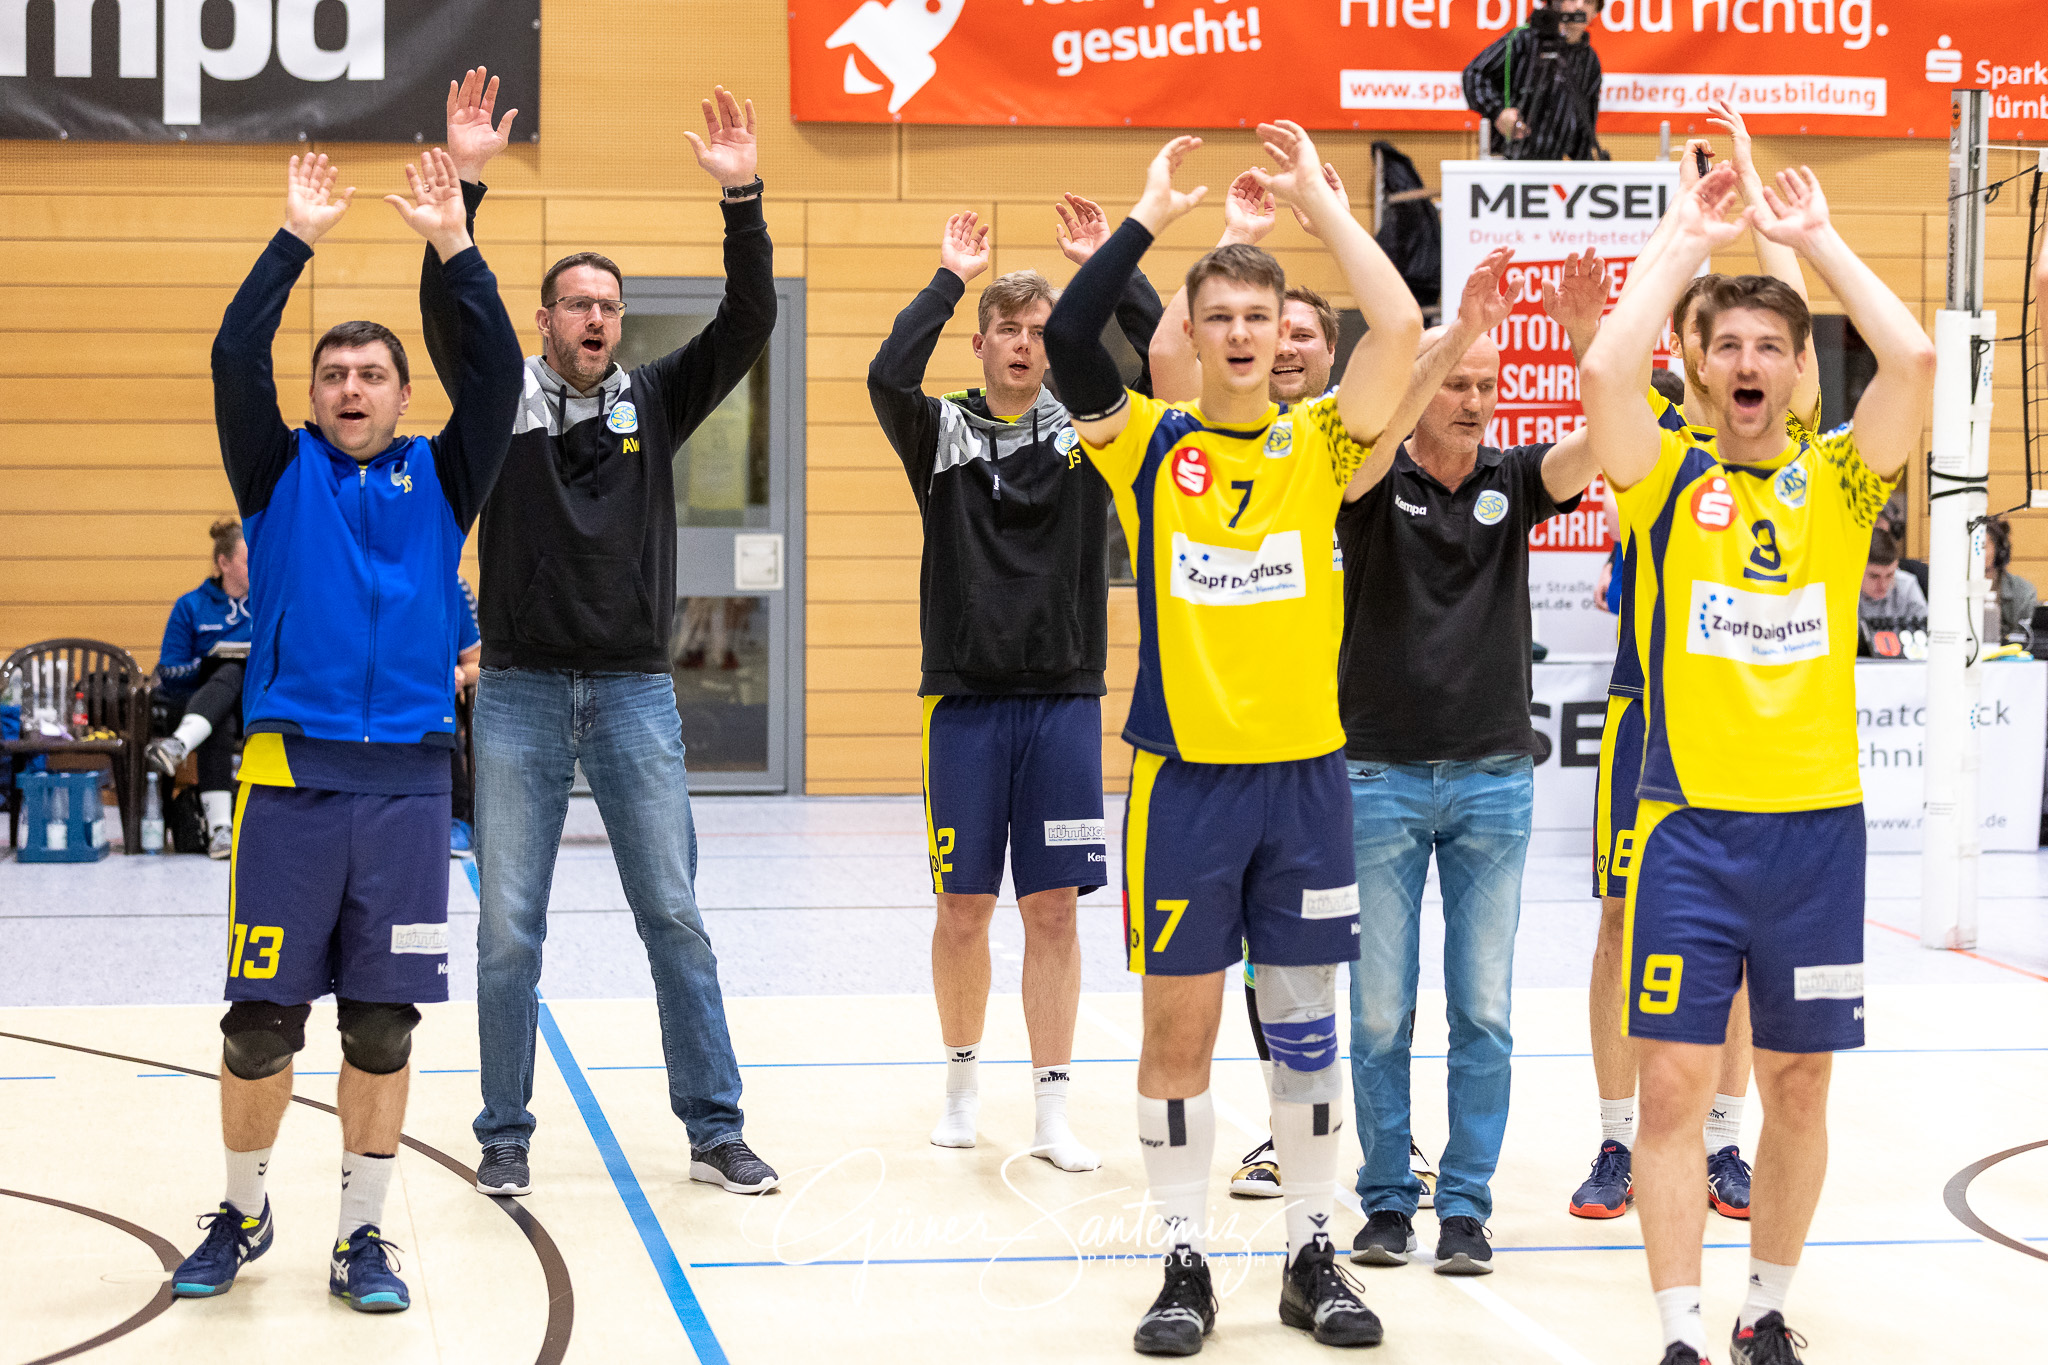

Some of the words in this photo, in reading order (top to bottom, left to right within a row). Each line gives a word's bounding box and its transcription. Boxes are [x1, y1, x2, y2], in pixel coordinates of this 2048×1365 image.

[1051, 6, 1262, 77] gesucht!
[1339, 0, 1451, 30] Hier
[1692, 0, 1890, 51] richtig.
[1468, 228, 1525, 245] Druck
[1067, 448, 1082, 470] JS
[1228, 480, 1255, 529] 7
[1394, 494, 1428, 517] Kempa
[1188, 566, 1228, 589] Zapf
[1712, 614, 1750, 638] Zapf
[936, 827, 956, 873] 2
[1152, 899, 1190, 953] 7
[229, 922, 285, 980] 13
[1638, 953, 1684, 1015] 9
